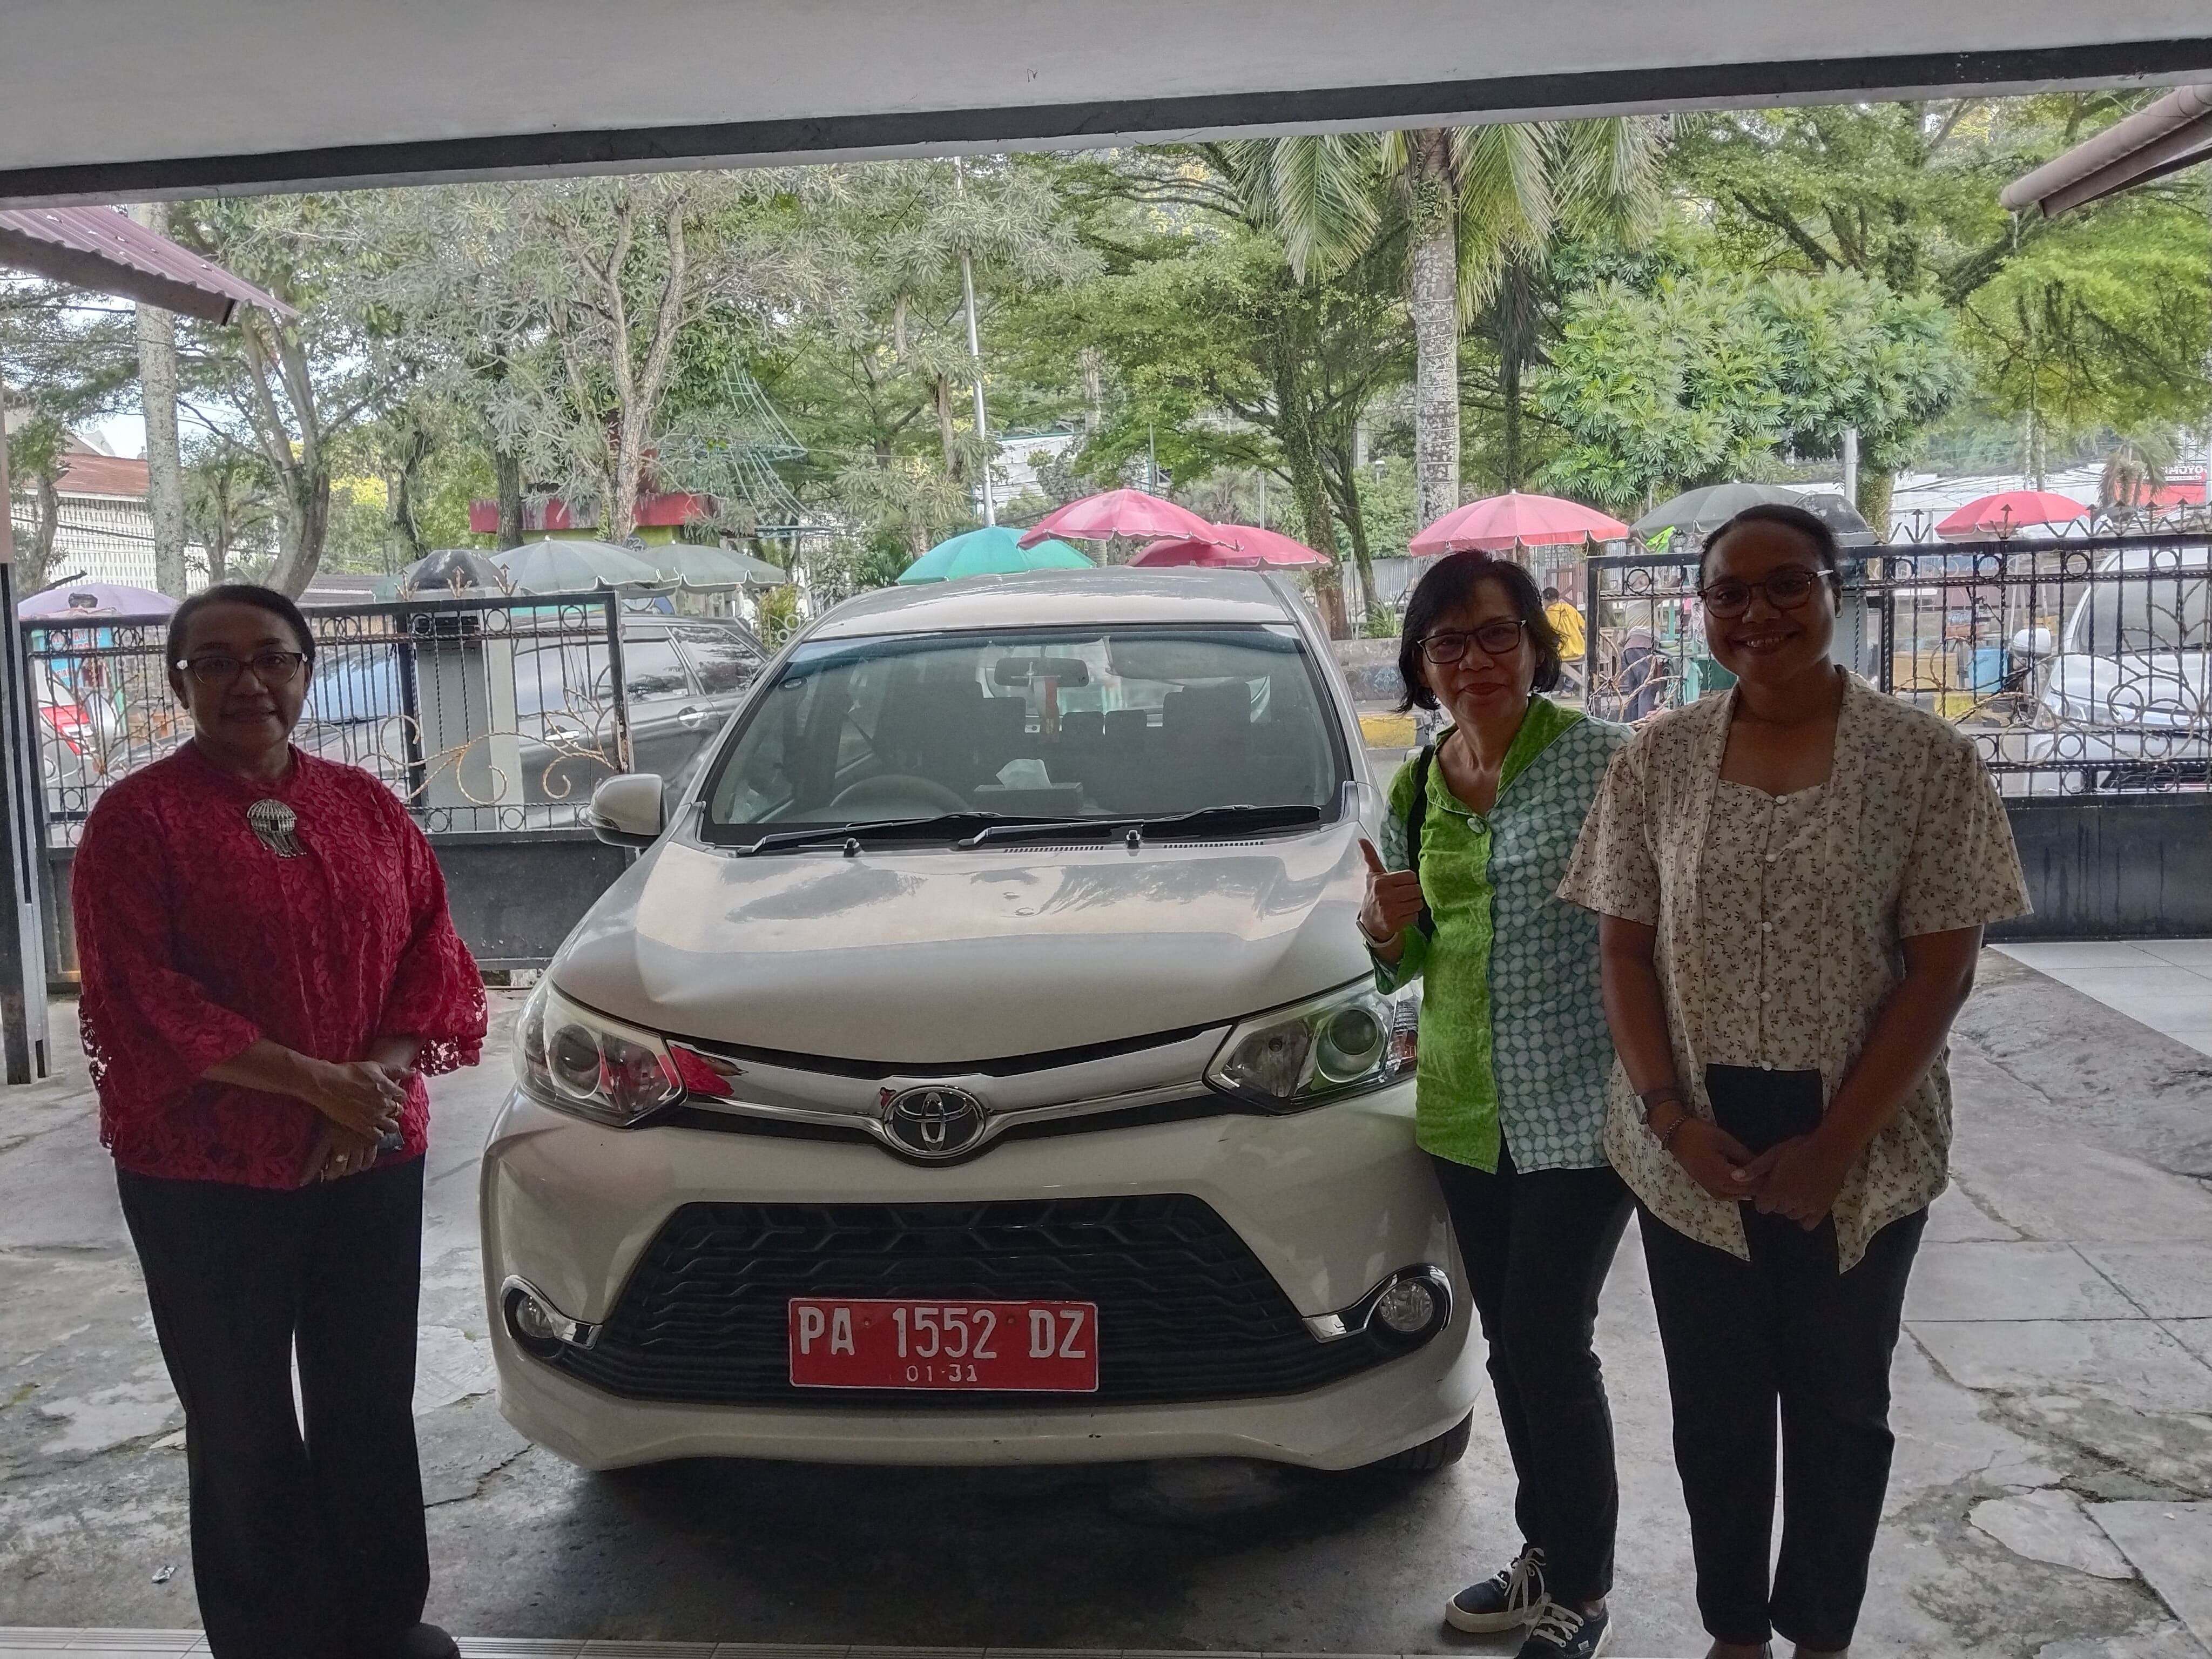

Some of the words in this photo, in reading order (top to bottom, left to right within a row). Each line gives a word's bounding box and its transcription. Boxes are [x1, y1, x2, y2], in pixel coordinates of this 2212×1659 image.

[798, 1306, 855, 1356] PA
[893, 1307, 997, 1359] 1552
[1028, 1309, 1086, 1359] DZ
